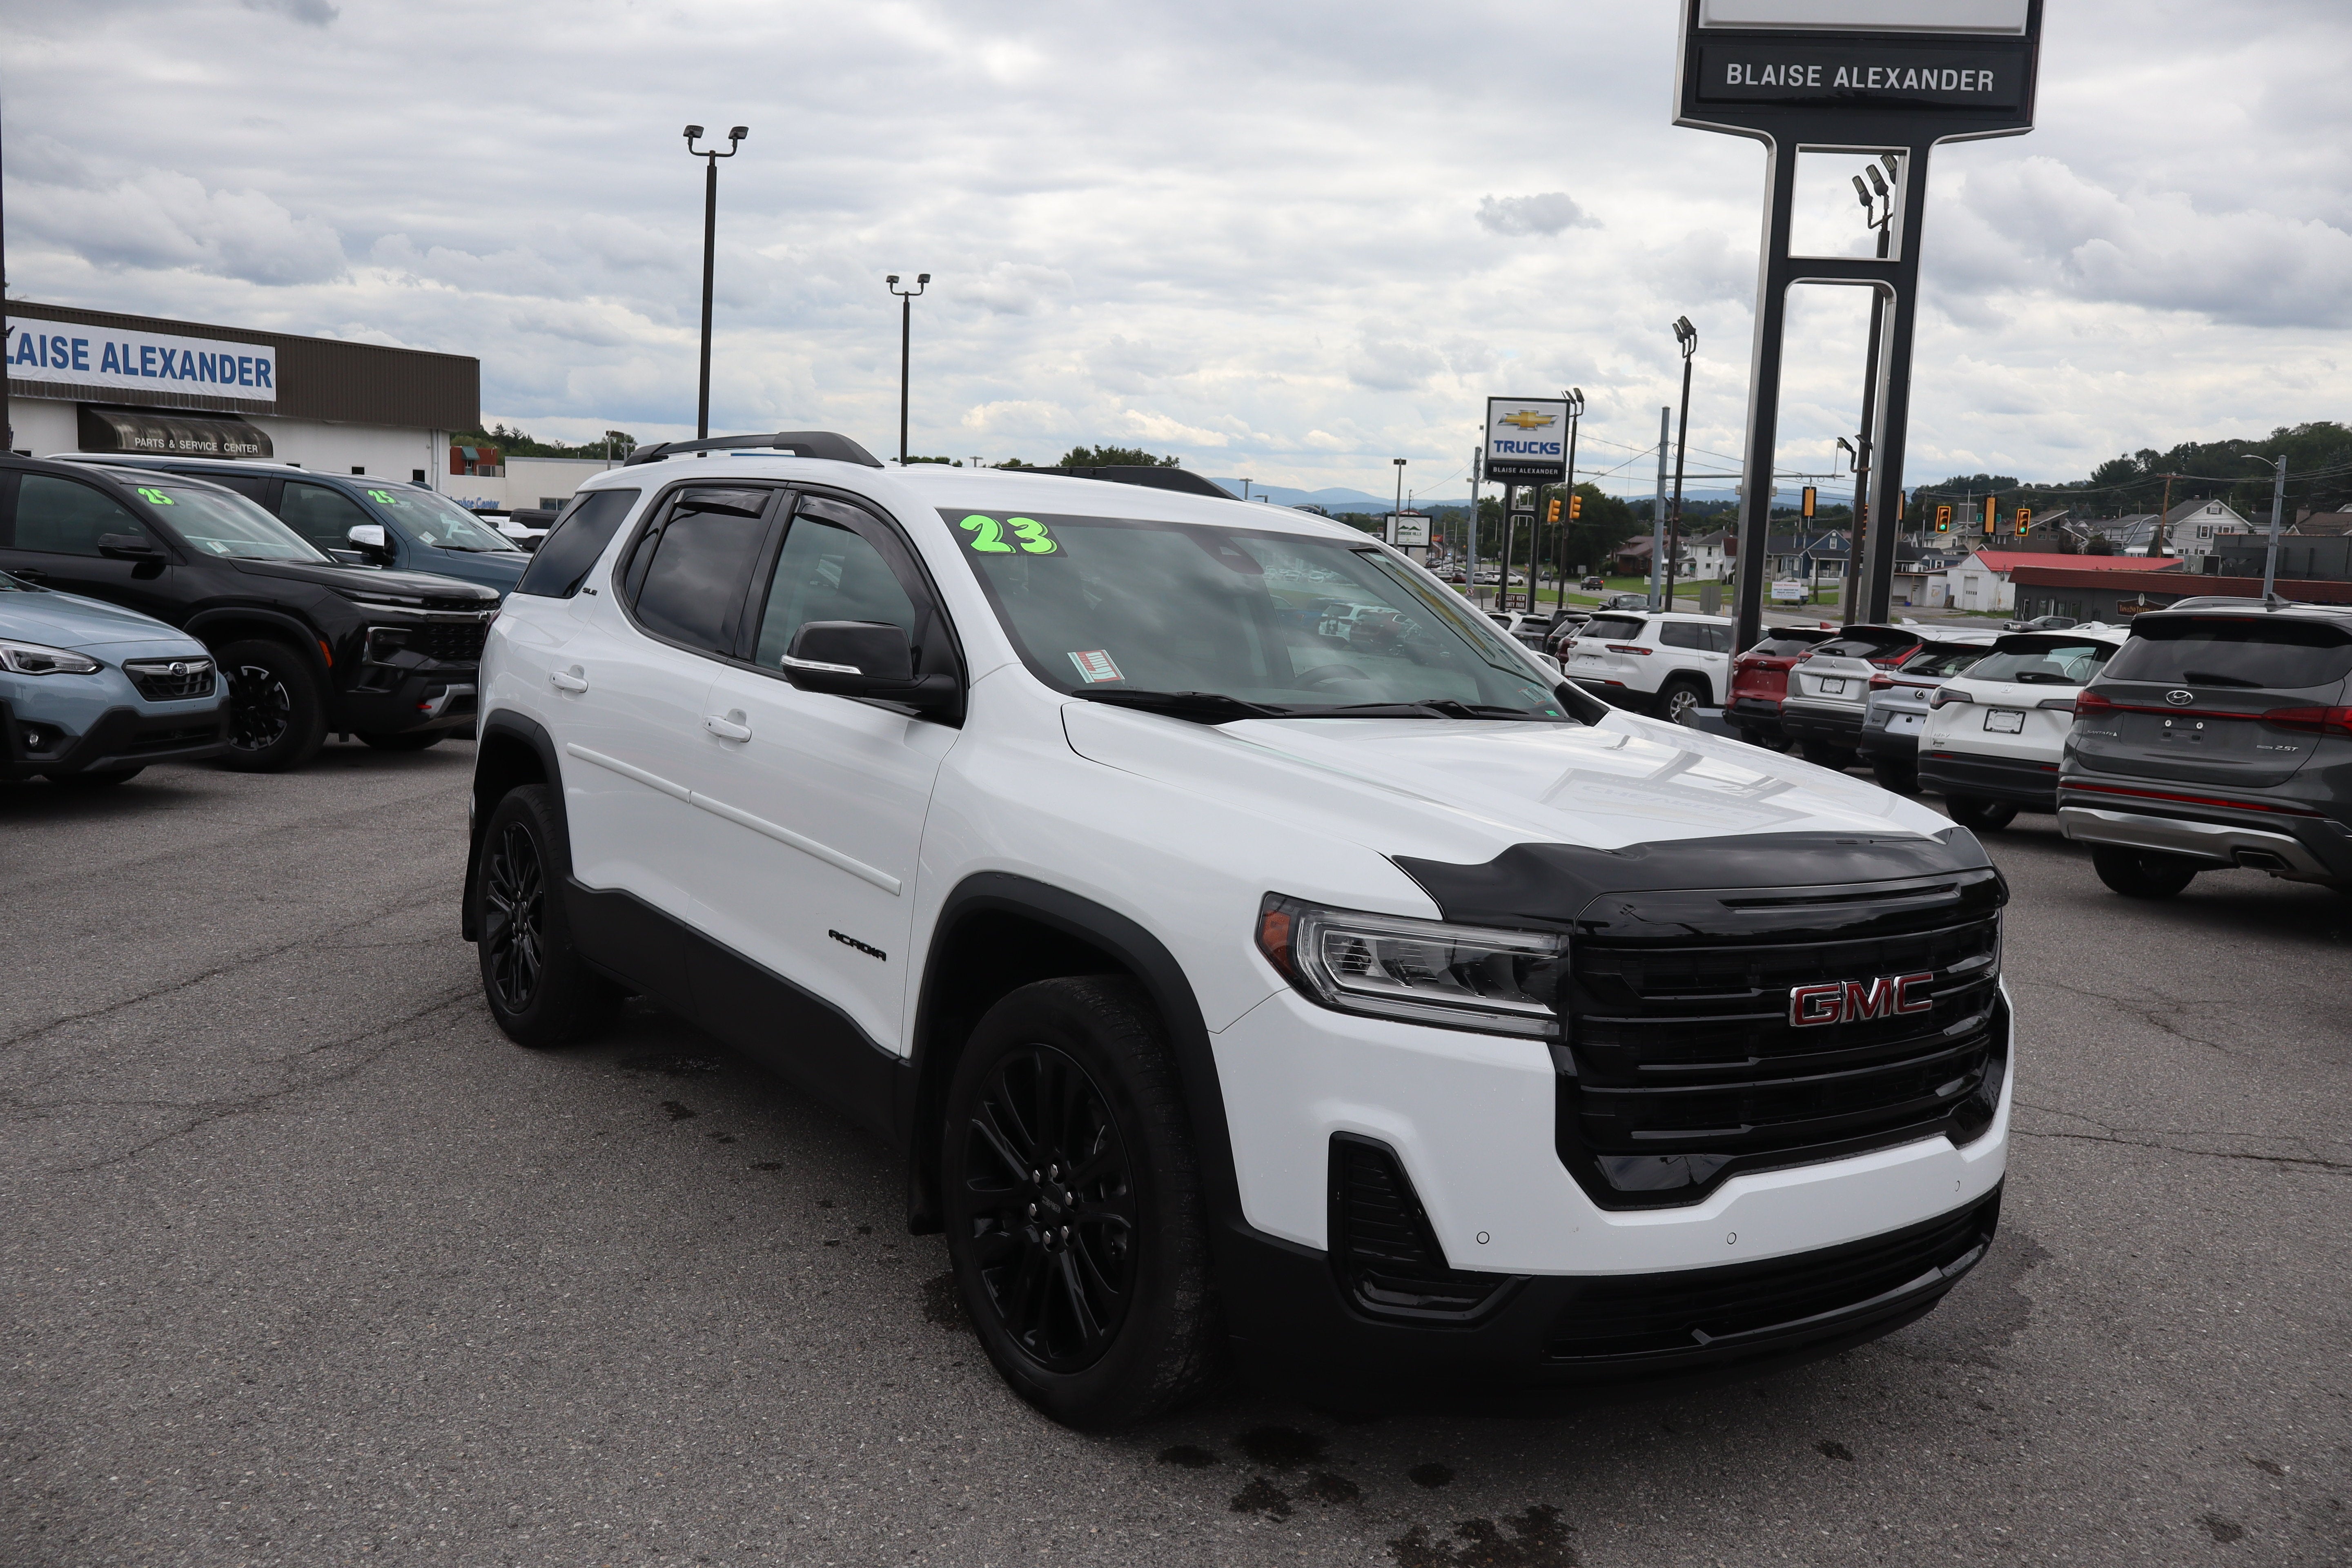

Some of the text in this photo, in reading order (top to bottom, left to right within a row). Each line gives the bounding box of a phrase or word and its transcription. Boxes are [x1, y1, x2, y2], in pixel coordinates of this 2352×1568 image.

[1726, 63, 1994, 92] BLAISE ALEXANDER
[7, 332, 273, 388] AISE ALEXANDER
[134, 437, 258, 453] PARTS & SERVICE CENTER
[1494, 440, 1561, 455] TRUCKS
[138, 487, 175, 506] 25
[368, 490, 396, 504] 25
[960, 514, 1058, 555] 23
[828, 929, 886, 962] ACADIA
[1789, 971, 1933, 1027] GMC
